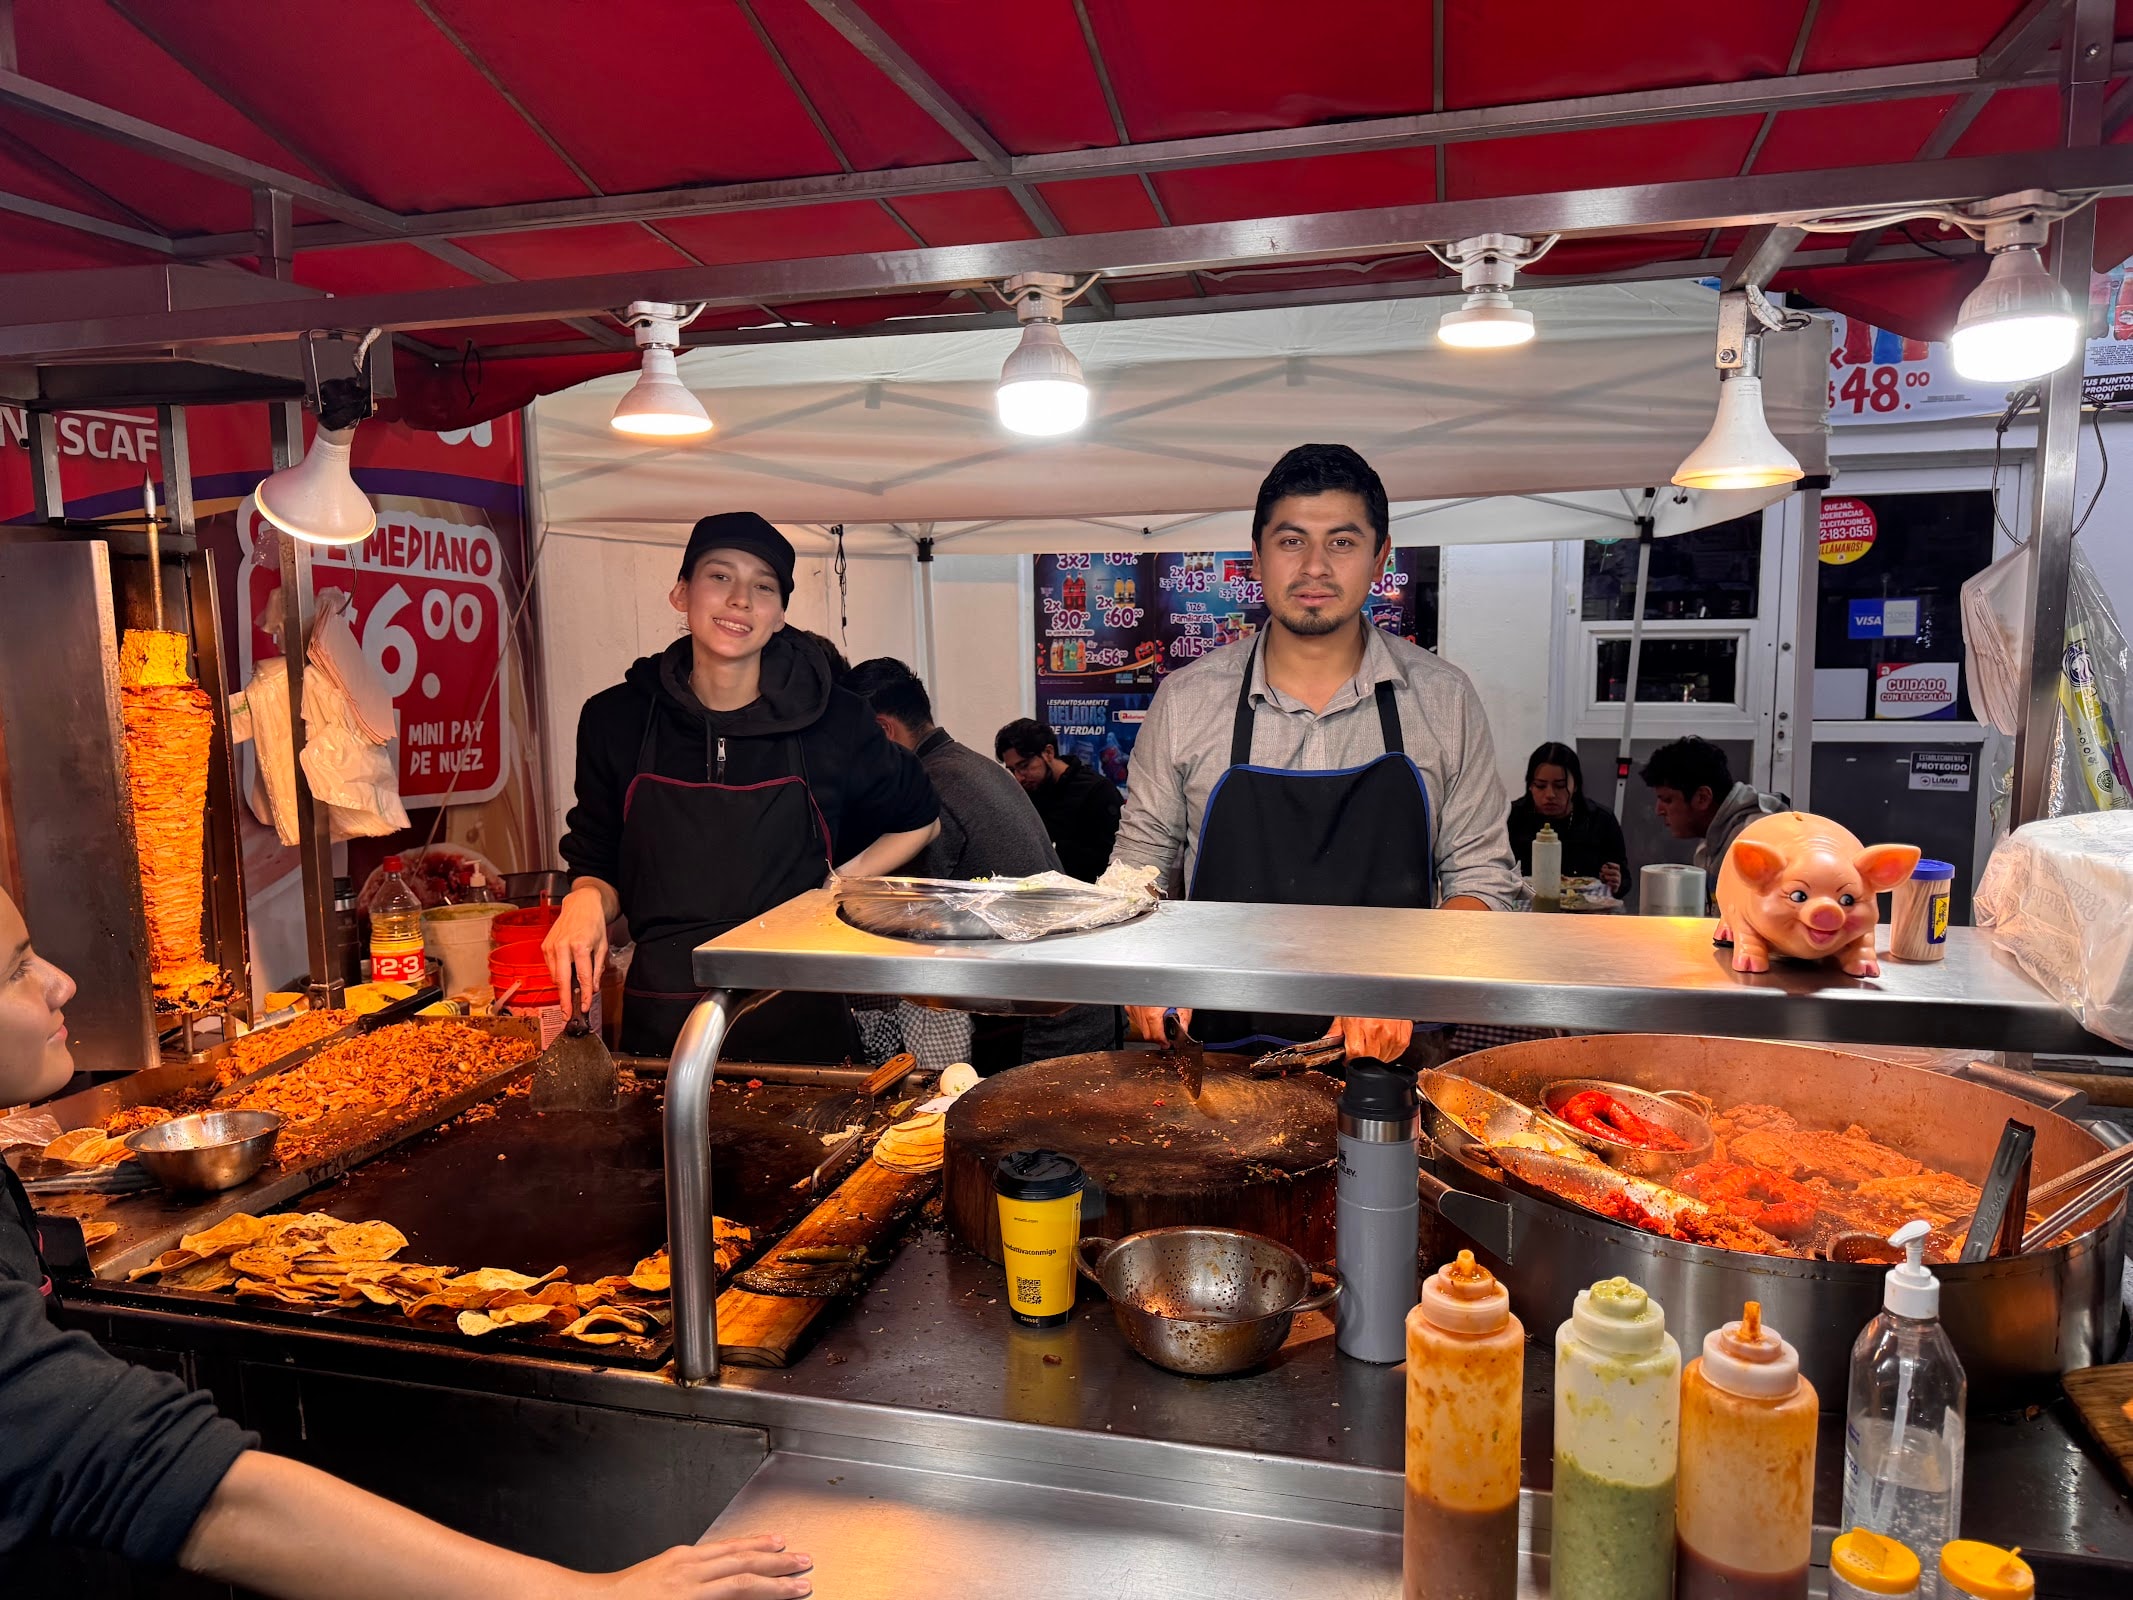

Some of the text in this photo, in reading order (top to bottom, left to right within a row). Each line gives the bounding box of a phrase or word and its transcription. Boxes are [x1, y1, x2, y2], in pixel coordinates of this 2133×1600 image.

[0, 407, 158, 463] NSCAF
[1820, 510, 1864, 520] UGERENCIAS
[1820, 517, 1871, 528] ELICITACIONES
[1820, 525, 1873, 540] 2-183-0551
[363, 524, 493, 577] MEDIANO
[1170, 566, 1185, 578] 2x
[1230, 577, 1246, 588] 2x
[1044, 599, 1061, 612] 2x
[1096, 595, 1113, 610] 2x
[1170, 613, 1213, 624] Familiares
[1855, 616, 1882, 626] VISA
[1184, 624, 1200, 635] 2x
[1887, 679, 1946, 691] CUIDADO
[1881, 691, 1952, 702] CON EL ESCALÓN
[1048, 706, 1107, 725] HELADAS
[408, 720, 484, 746] MINI PAY
[1063, 726, 1106, 735] VERDAD!
[410, 749, 484, 775] DE NUEZ
[1916, 762, 1968, 771] PROTEGIDO
